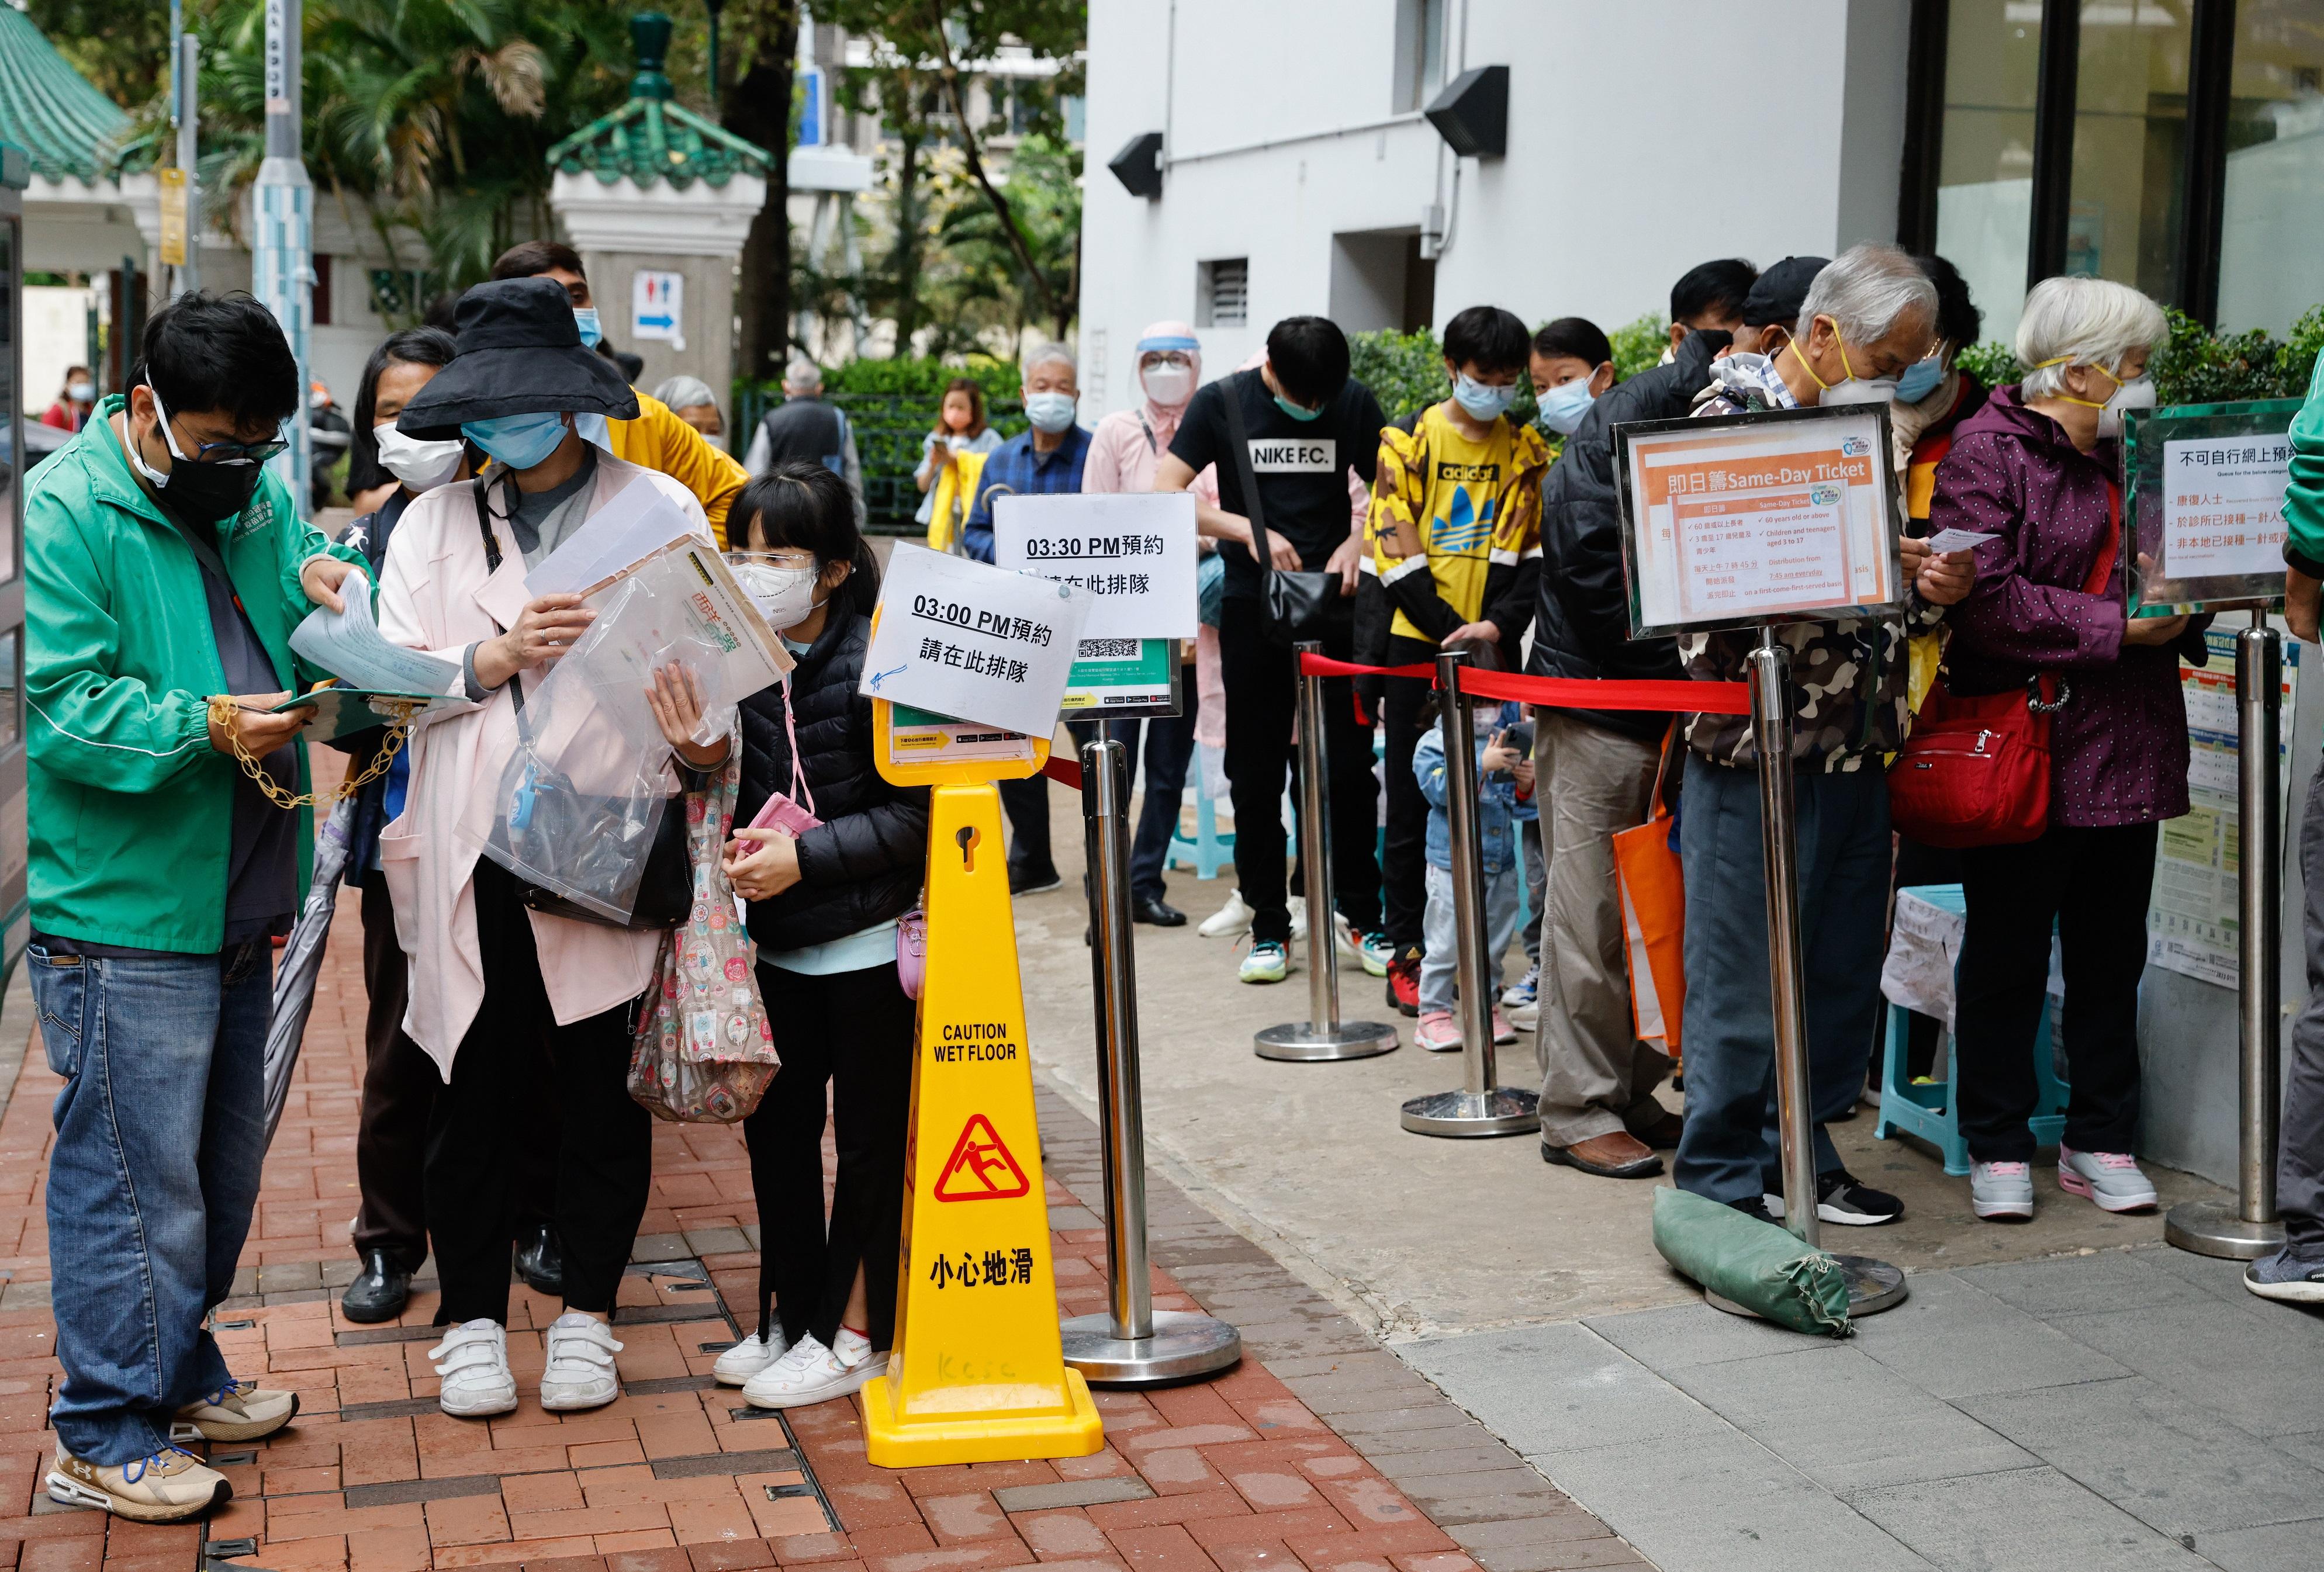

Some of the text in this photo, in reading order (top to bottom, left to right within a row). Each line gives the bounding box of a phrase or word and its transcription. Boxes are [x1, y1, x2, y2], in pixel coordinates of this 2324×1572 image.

[1254, 448, 1328, 465] NIKE F.C.
[1815, 462, 1865, 480] Ticket
[1759, 498, 1790, 508] Same-Day
[2177, 493, 2223, 506] 康復人士
[1766, 528, 1792, 536] Children
[1806, 525, 1836, 534] teenagers
[1026, 538, 1081, 557] 03:30
[1696, 546, 1716, 555] 青少年
[1694, 563, 1723, 573] 每天上午
[1769, 557, 1805, 566] Distribution
[1795, 569, 1822, 578] everyday
[1706, 576, 1735, 585] 開始派發
[1759, 581, 1825, 594] first-come-first-served
[1707, 590, 1736, 599] 派完即止
[913, 594, 971, 625] 03:00
[919, 637, 1029, 684] 請在此排隊
[943, 1023, 1007, 1041] CAUTION
[933, 1043, 1016, 1062] WET FLOOR
[929, 1247, 1033, 1290] 小心地滑
